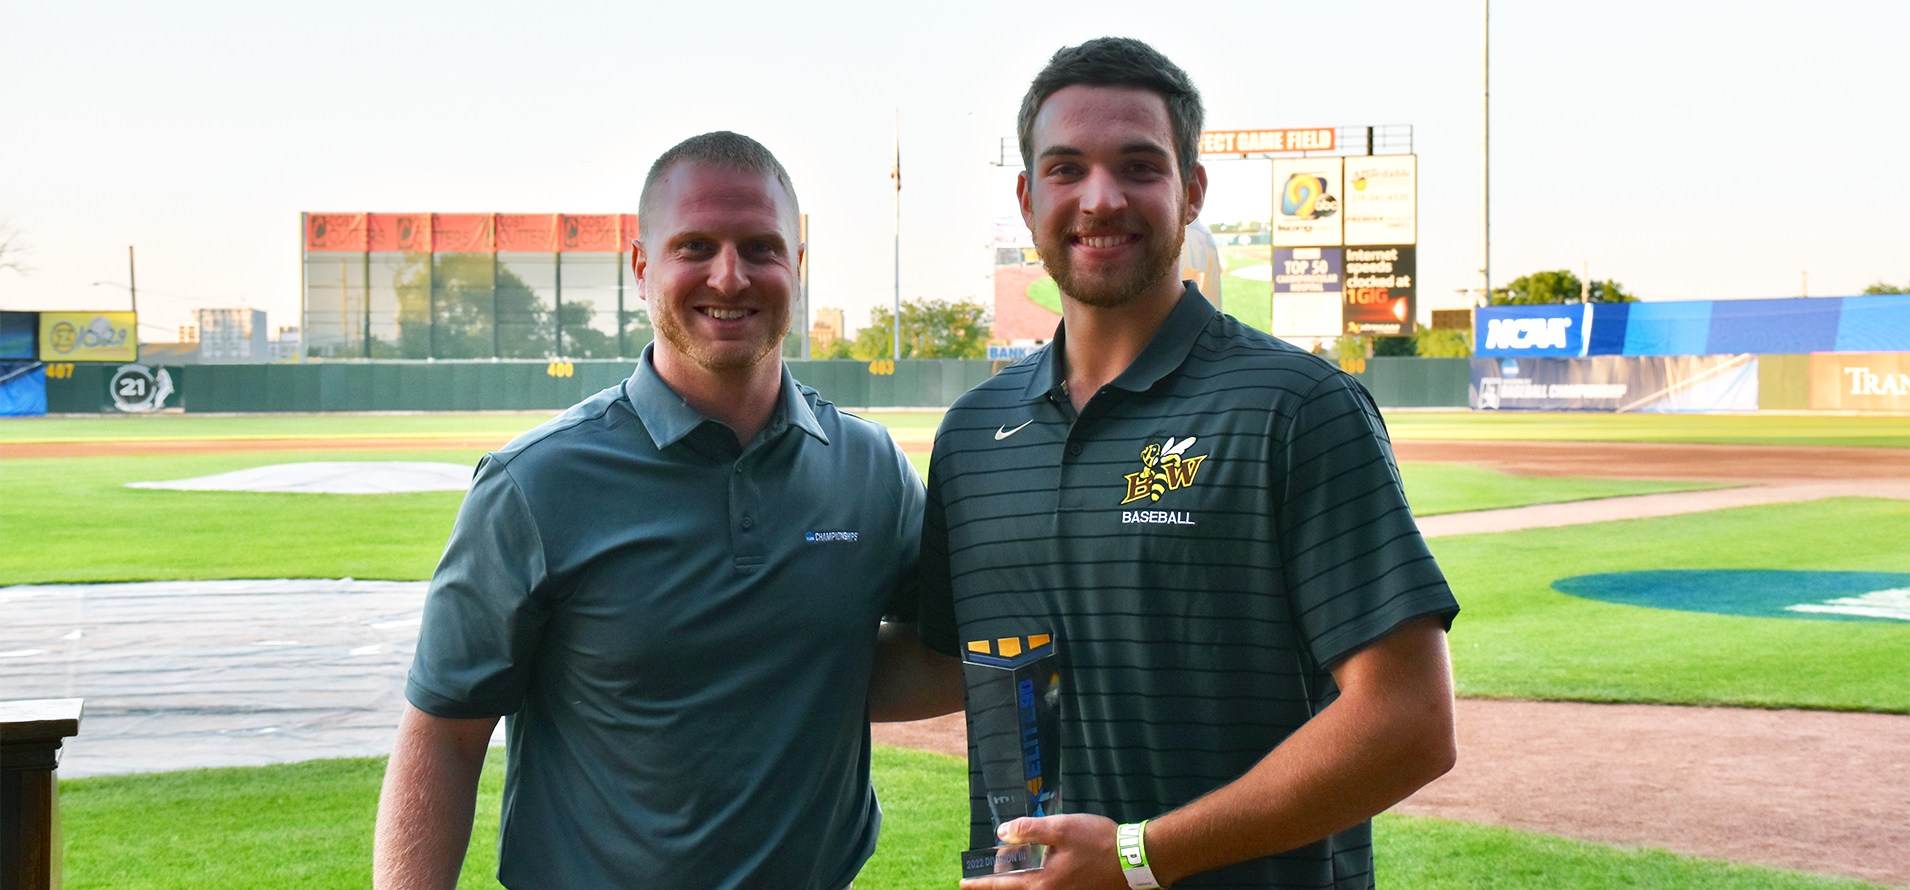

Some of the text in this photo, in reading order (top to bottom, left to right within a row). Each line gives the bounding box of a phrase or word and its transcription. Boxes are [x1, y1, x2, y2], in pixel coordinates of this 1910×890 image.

[1237, 131, 1284, 151] GAME
[1286, 129, 1332, 149] FIELD
[1314, 197, 1338, 211] abc
[1346, 248, 1399, 261] Internet
[1283, 259, 1329, 275] TOP 50
[1346, 260, 1393, 276] speeds
[1346, 274, 1411, 288] clocked at
[1485, 318, 1567, 349] NCAA
[989, 346, 1025, 359] BANK
[46, 363, 75, 379] 407
[547, 362, 574, 378] 400
[869, 359, 895, 375] 403
[119, 378, 146, 396] 21
[1121, 511, 1196, 525] BASEBALL
[1119, 823, 1143, 865] VIP
[966, 858, 984, 870] 2022
